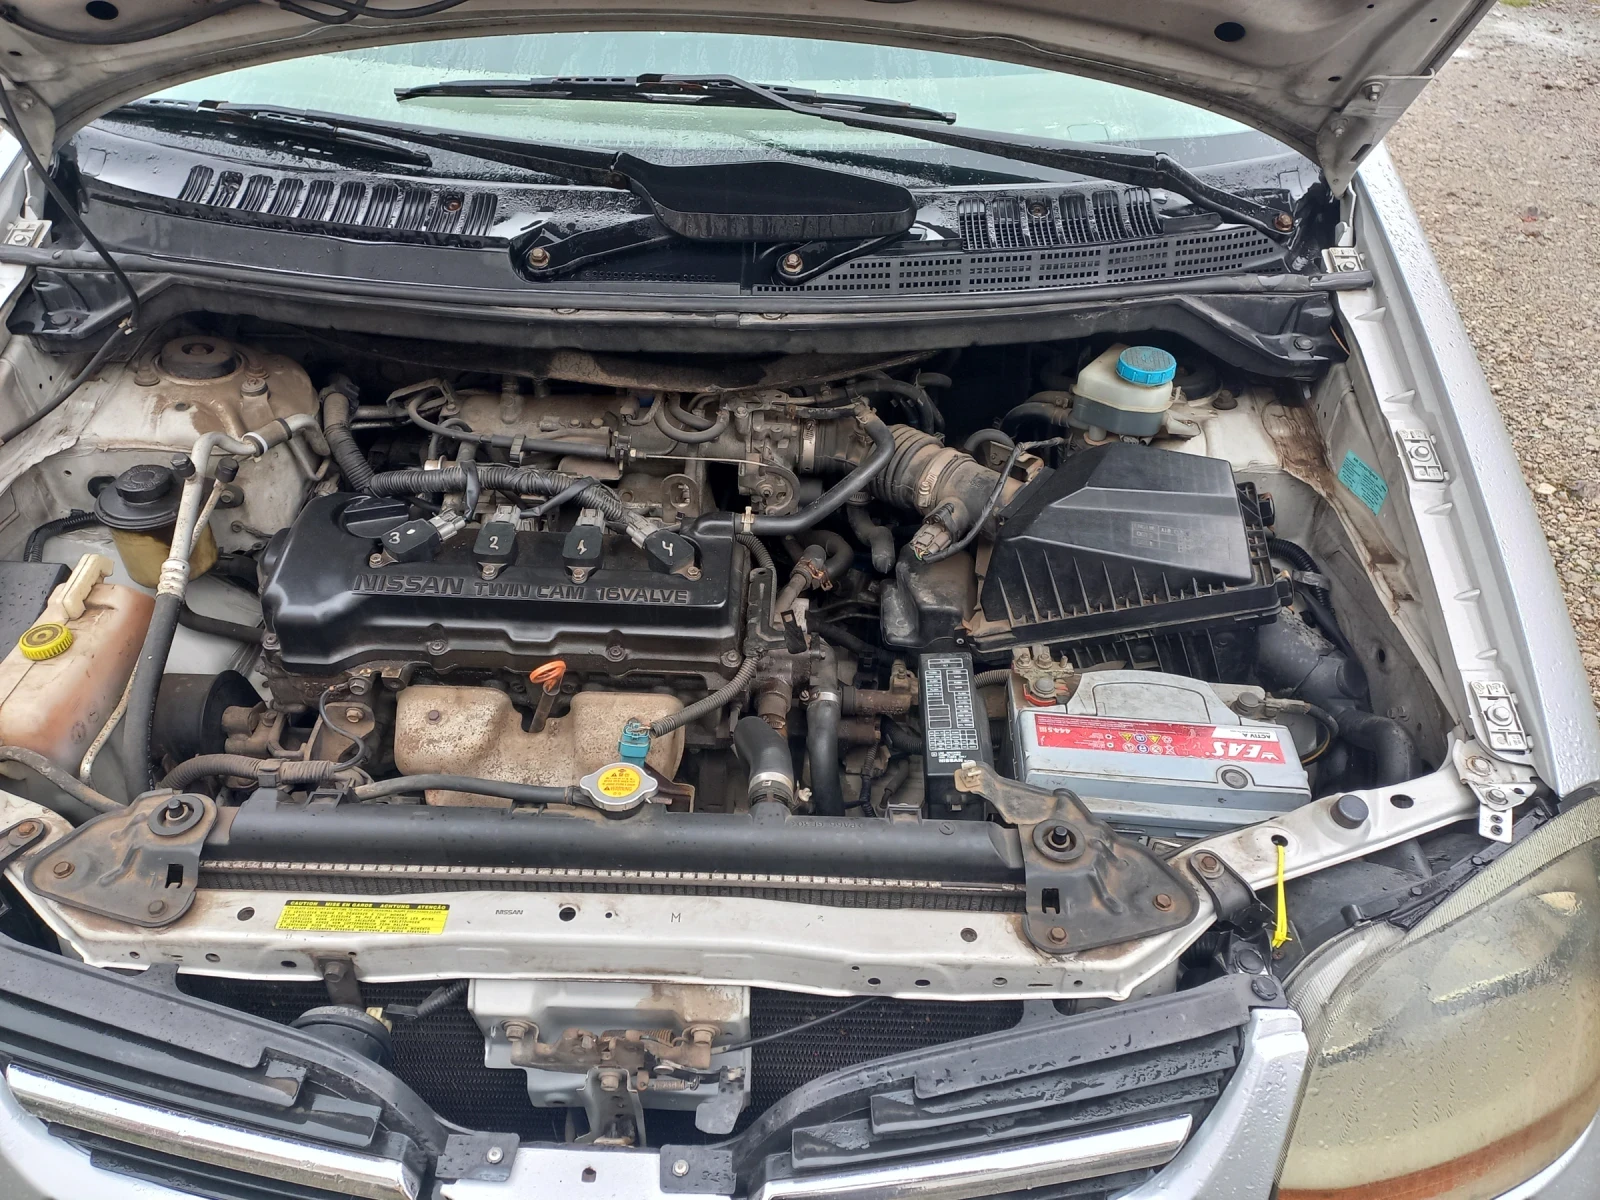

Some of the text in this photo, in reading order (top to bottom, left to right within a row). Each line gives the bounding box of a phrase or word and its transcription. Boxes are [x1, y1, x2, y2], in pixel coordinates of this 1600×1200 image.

[388, 531, 401, 544] 3
[489, 535, 499, 550] 2
[661, 540, 674, 557] 4
[353, 574, 689, 604] NISSAN TWIN CAM 16VALVE
[1211, 741, 1262, 759] EAS
[670, 912, 682, 923] M
